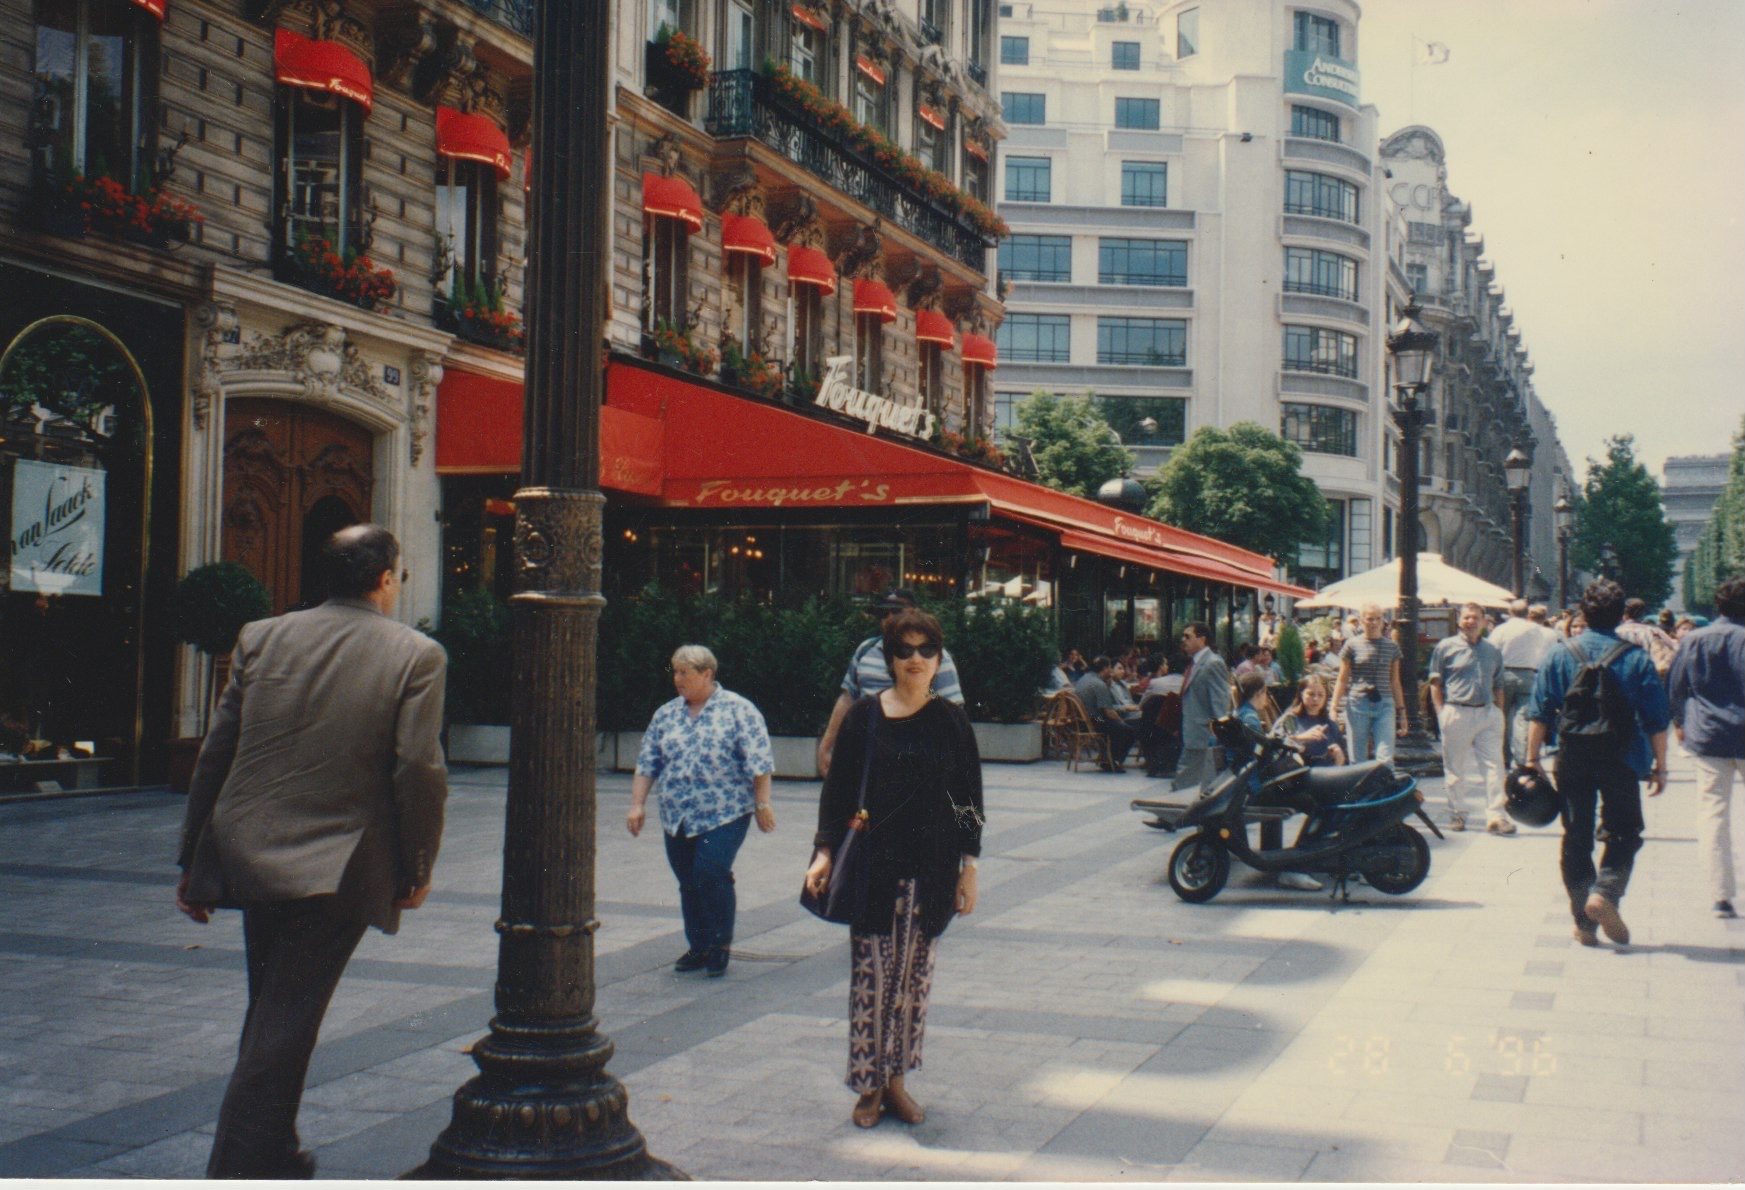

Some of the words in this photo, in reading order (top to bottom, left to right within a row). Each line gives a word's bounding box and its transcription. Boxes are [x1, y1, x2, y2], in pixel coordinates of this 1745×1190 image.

[387, 367, 399, 384] 99
[815, 355, 936, 440] Fouquet's
[696, 479, 889, 506] Fouquet's
